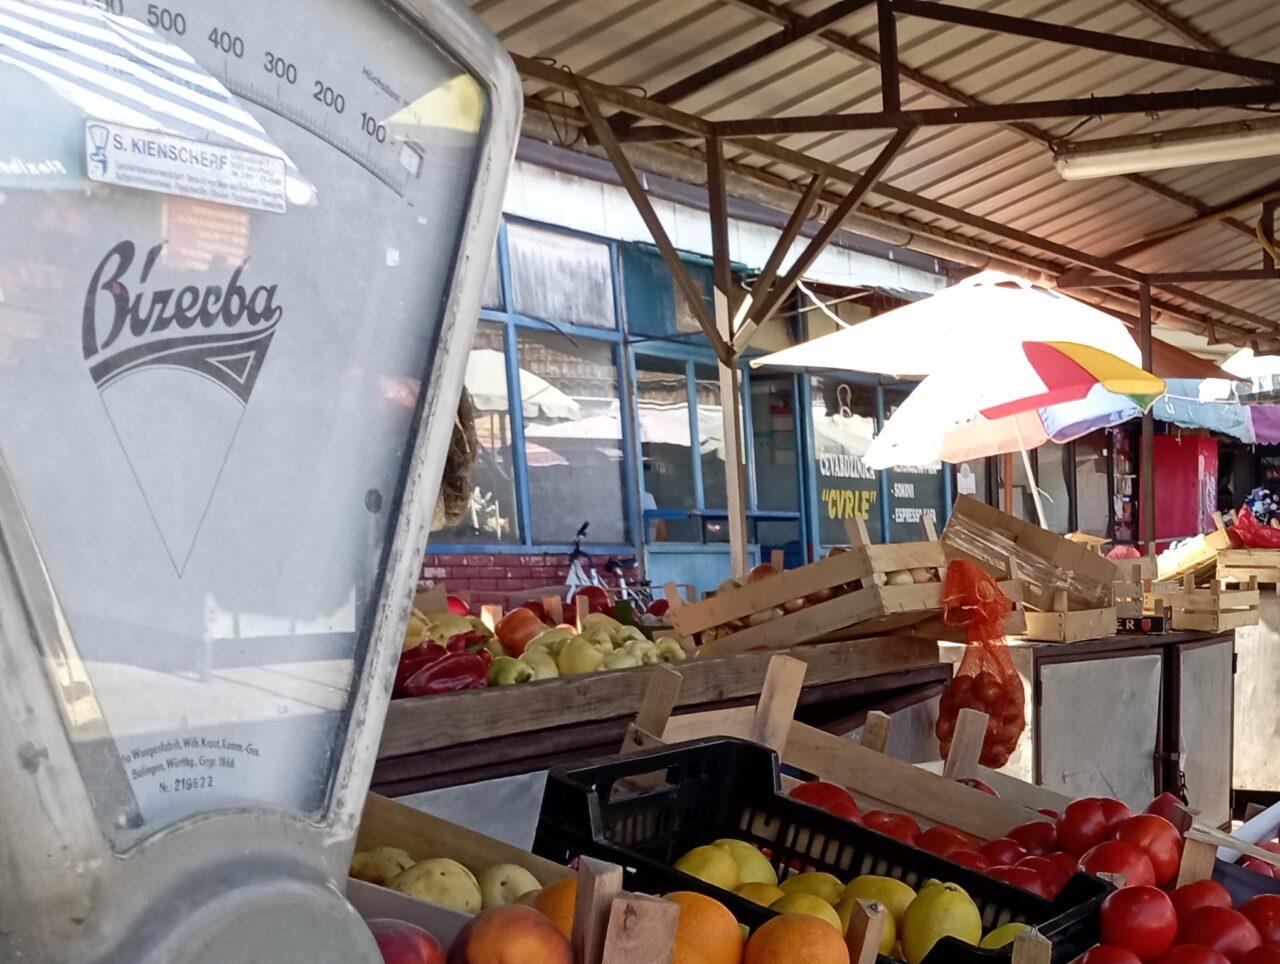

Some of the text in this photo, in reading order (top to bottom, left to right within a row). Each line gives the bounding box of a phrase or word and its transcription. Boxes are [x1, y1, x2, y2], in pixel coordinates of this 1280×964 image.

[147, 4, 187, 36] 500
[207, 27, 244, 59] 400
[263, 51, 297, 85] 300
[312, 80, 346, 114] 200
[360, 111, 386, 144] 100
[113, 133, 128, 152] S.
[131, 138, 229, 171] KIENSCHERF
[82, 239, 283, 361] Bizerba
